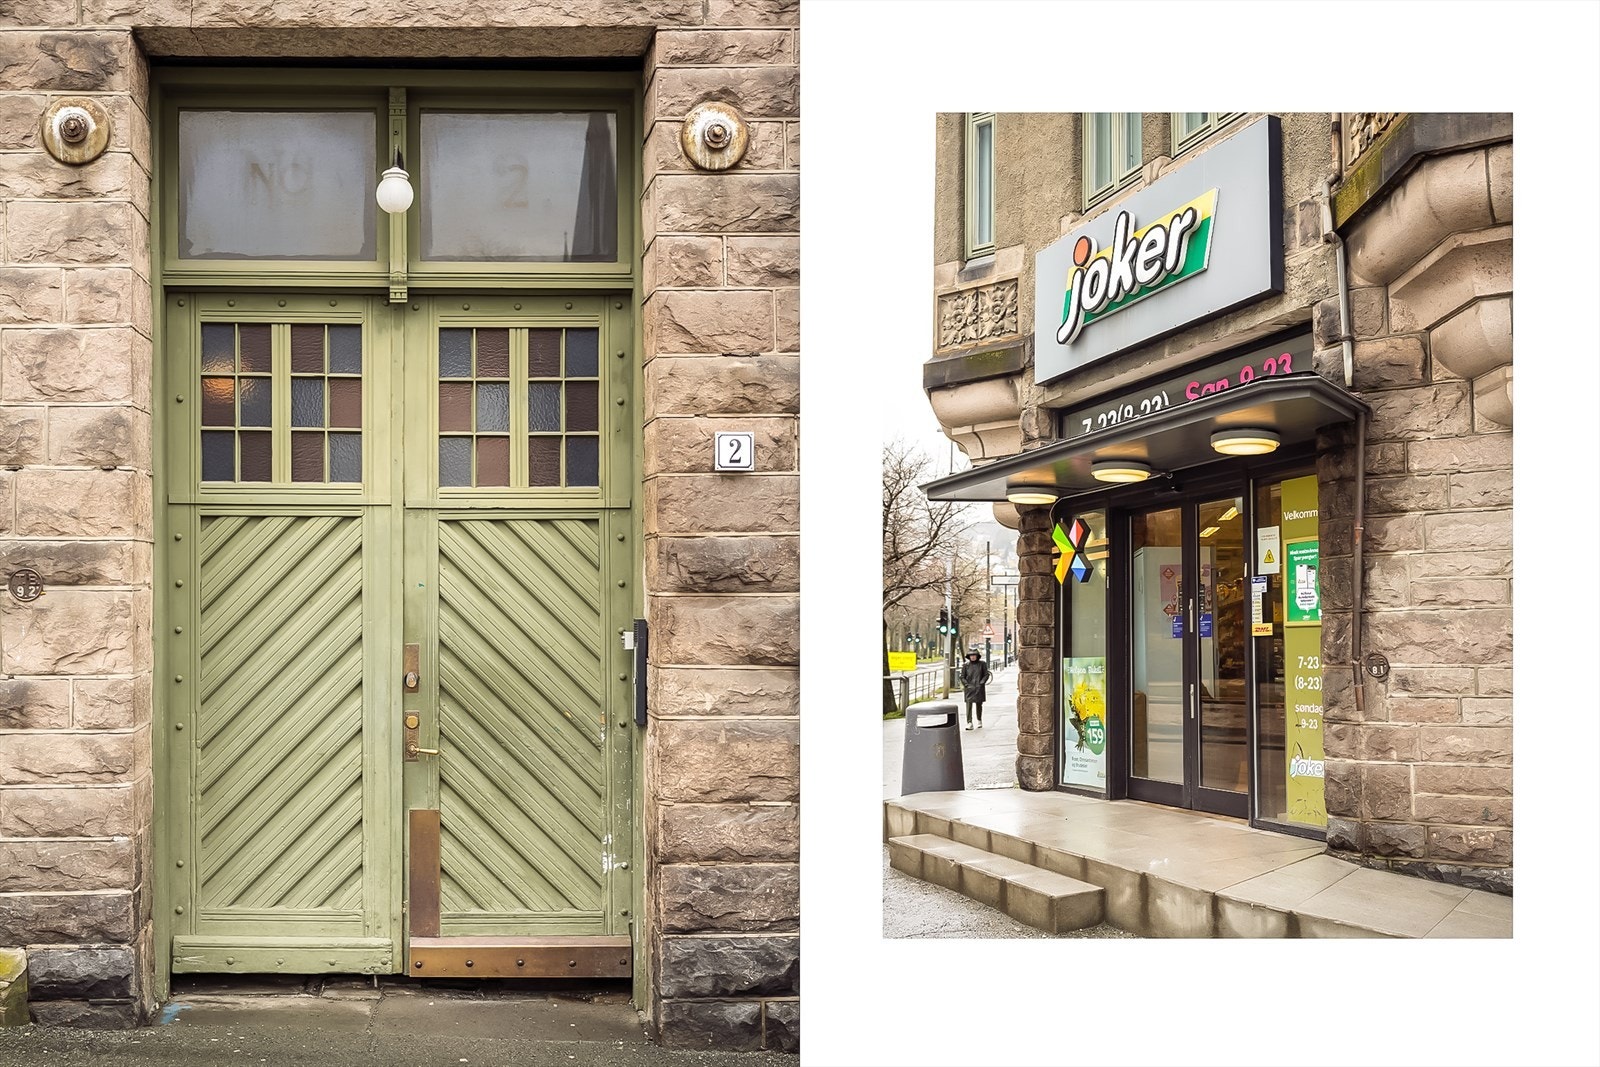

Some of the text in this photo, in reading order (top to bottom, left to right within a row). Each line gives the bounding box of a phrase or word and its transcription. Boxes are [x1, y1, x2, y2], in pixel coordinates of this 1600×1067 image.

[1056, 206, 1202, 347] joker
[729, 438, 742, 464] 2
[1283, 509, 1319, 521] Velkomm
[1298, 656, 1320, 669] 7-23
[1294, 674, 1323, 690] (8-23)
[1295, 703, 1324, 716] søndag
[1301, 718, 1318, 730] 9-23
[1087, 728, 1104, 744] 159
[1290, 754, 1324, 778] joke
